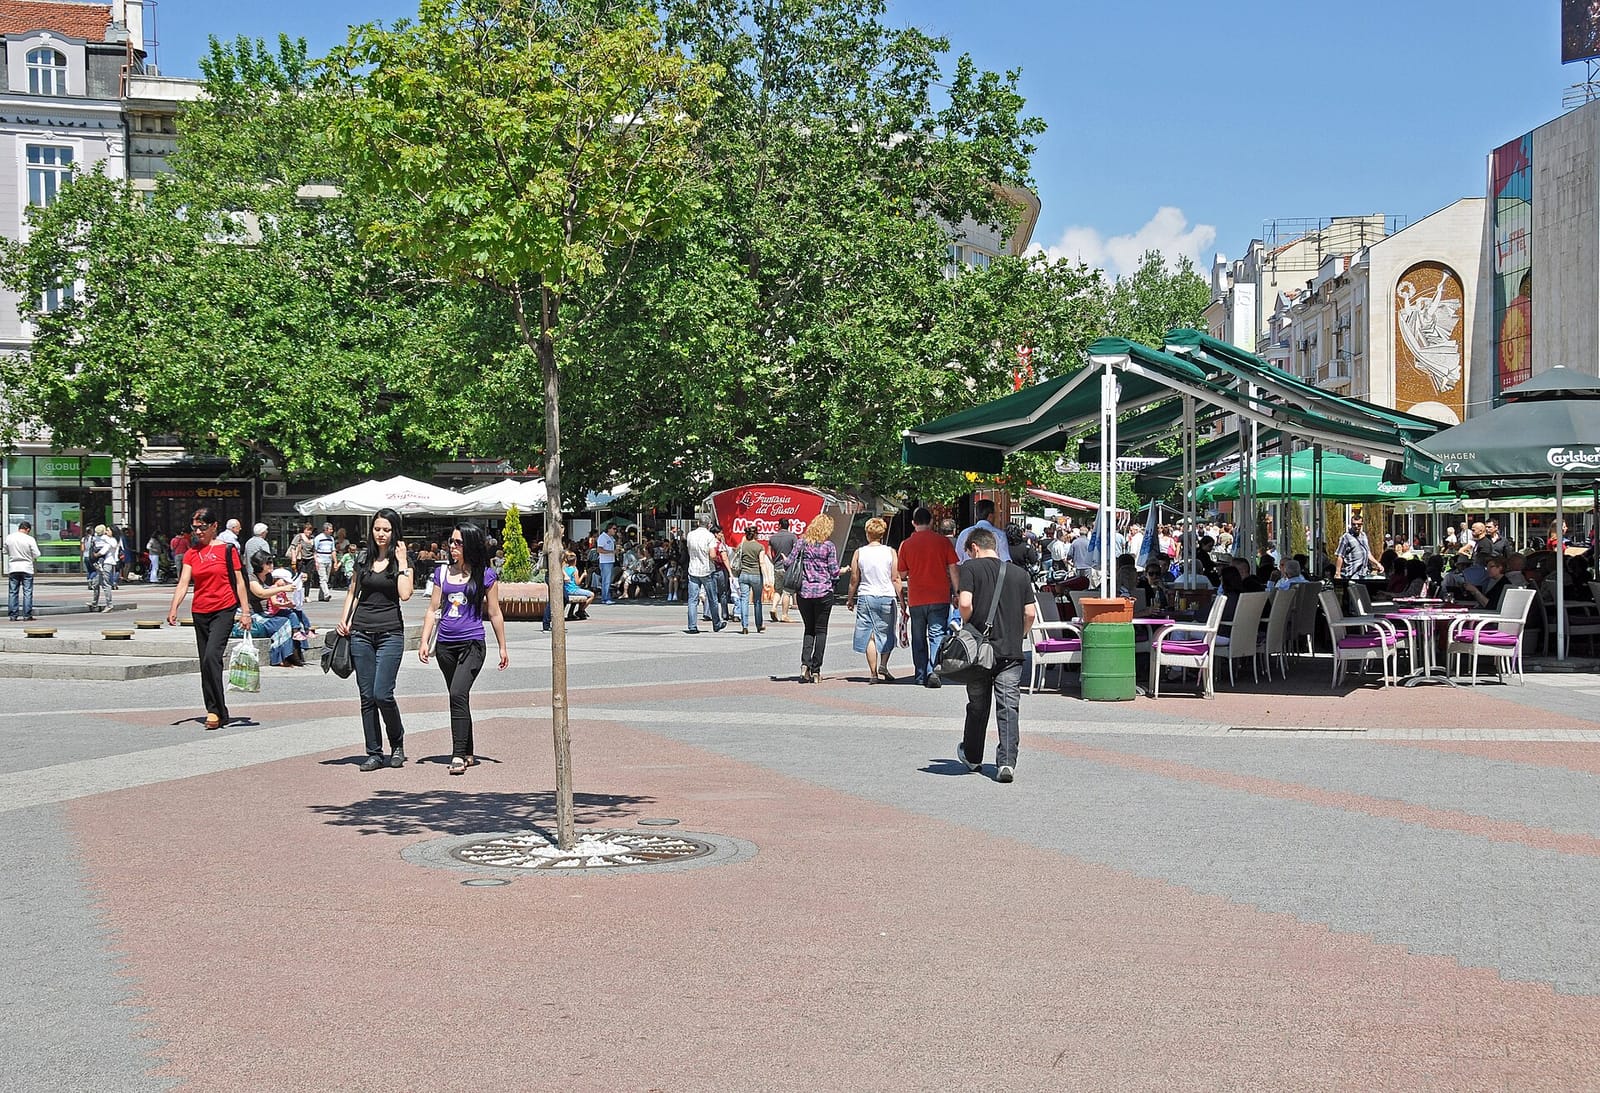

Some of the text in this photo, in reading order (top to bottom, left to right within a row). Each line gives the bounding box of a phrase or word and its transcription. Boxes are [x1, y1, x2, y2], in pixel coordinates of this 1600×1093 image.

[1436, 452, 1476, 460] NHAGEN
[1547, 447, 1600, 467] Carlsber
[45, 462, 80, 471] GLOBUL
[1444, 463, 1460, 473] 47
[196, 488, 240, 497] efbet
[736, 492, 791, 508] La Fantasia
[755, 503, 771, 514] del
[754, 518, 803, 534] Swet's
